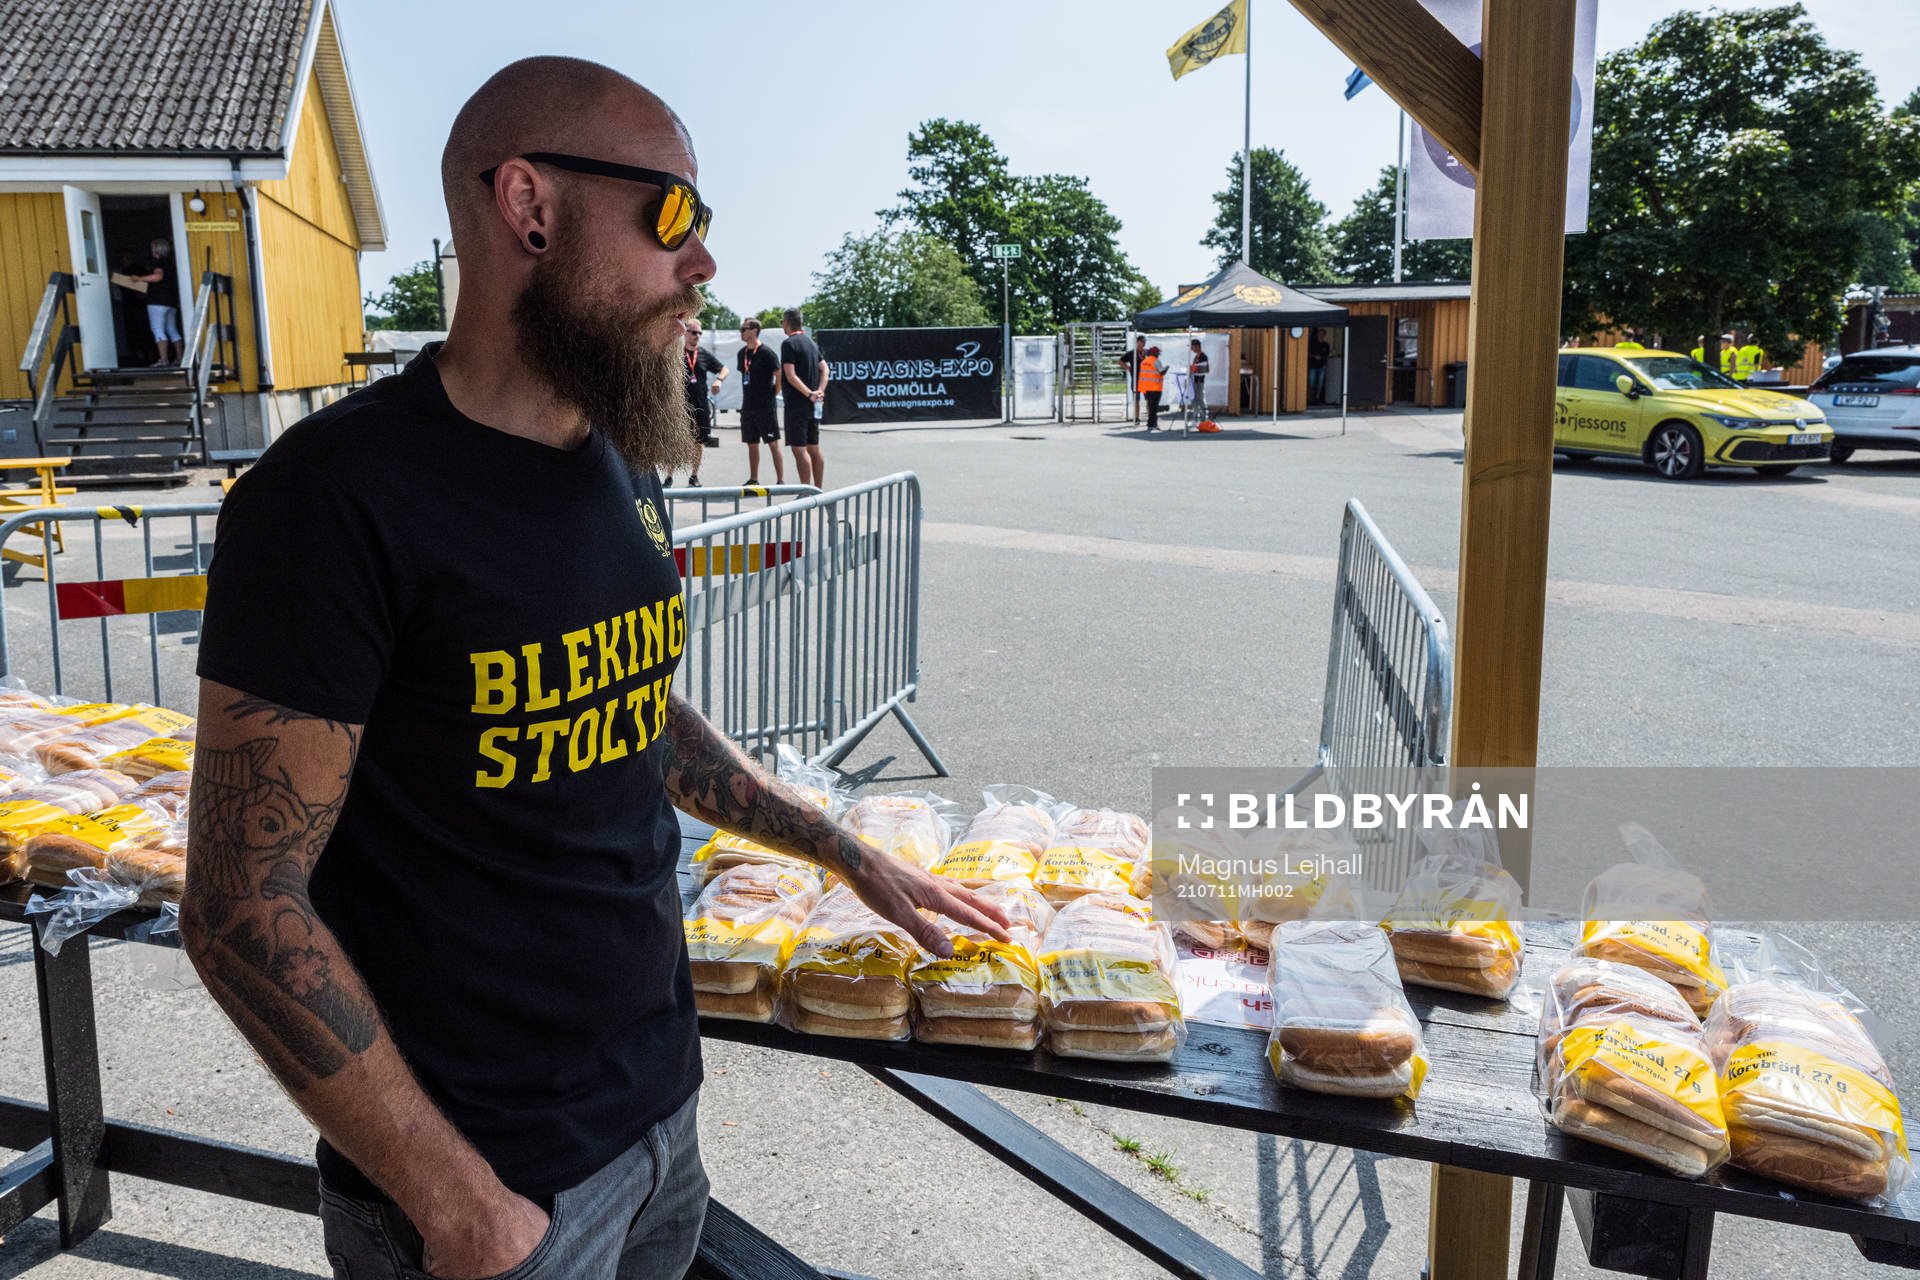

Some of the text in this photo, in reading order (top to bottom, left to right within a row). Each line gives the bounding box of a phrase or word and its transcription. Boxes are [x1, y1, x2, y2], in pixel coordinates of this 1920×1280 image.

[829, 358, 993, 381] HUSVAGNS-EXPO
[866, 381, 947, 398] BROMÖLLA
[857, 399, 954, 410] www.husvagnsexpo.se
[470, 592, 687, 715] BLEKING
[475, 674, 673, 788] STOLTH
[1674, 1065, 1691, 1082] 27
[1727, 1059, 1806, 1081] Korvbröd,
[1812, 1070, 1832, 1085] 27
[1837, 1081, 1847, 1093] g
